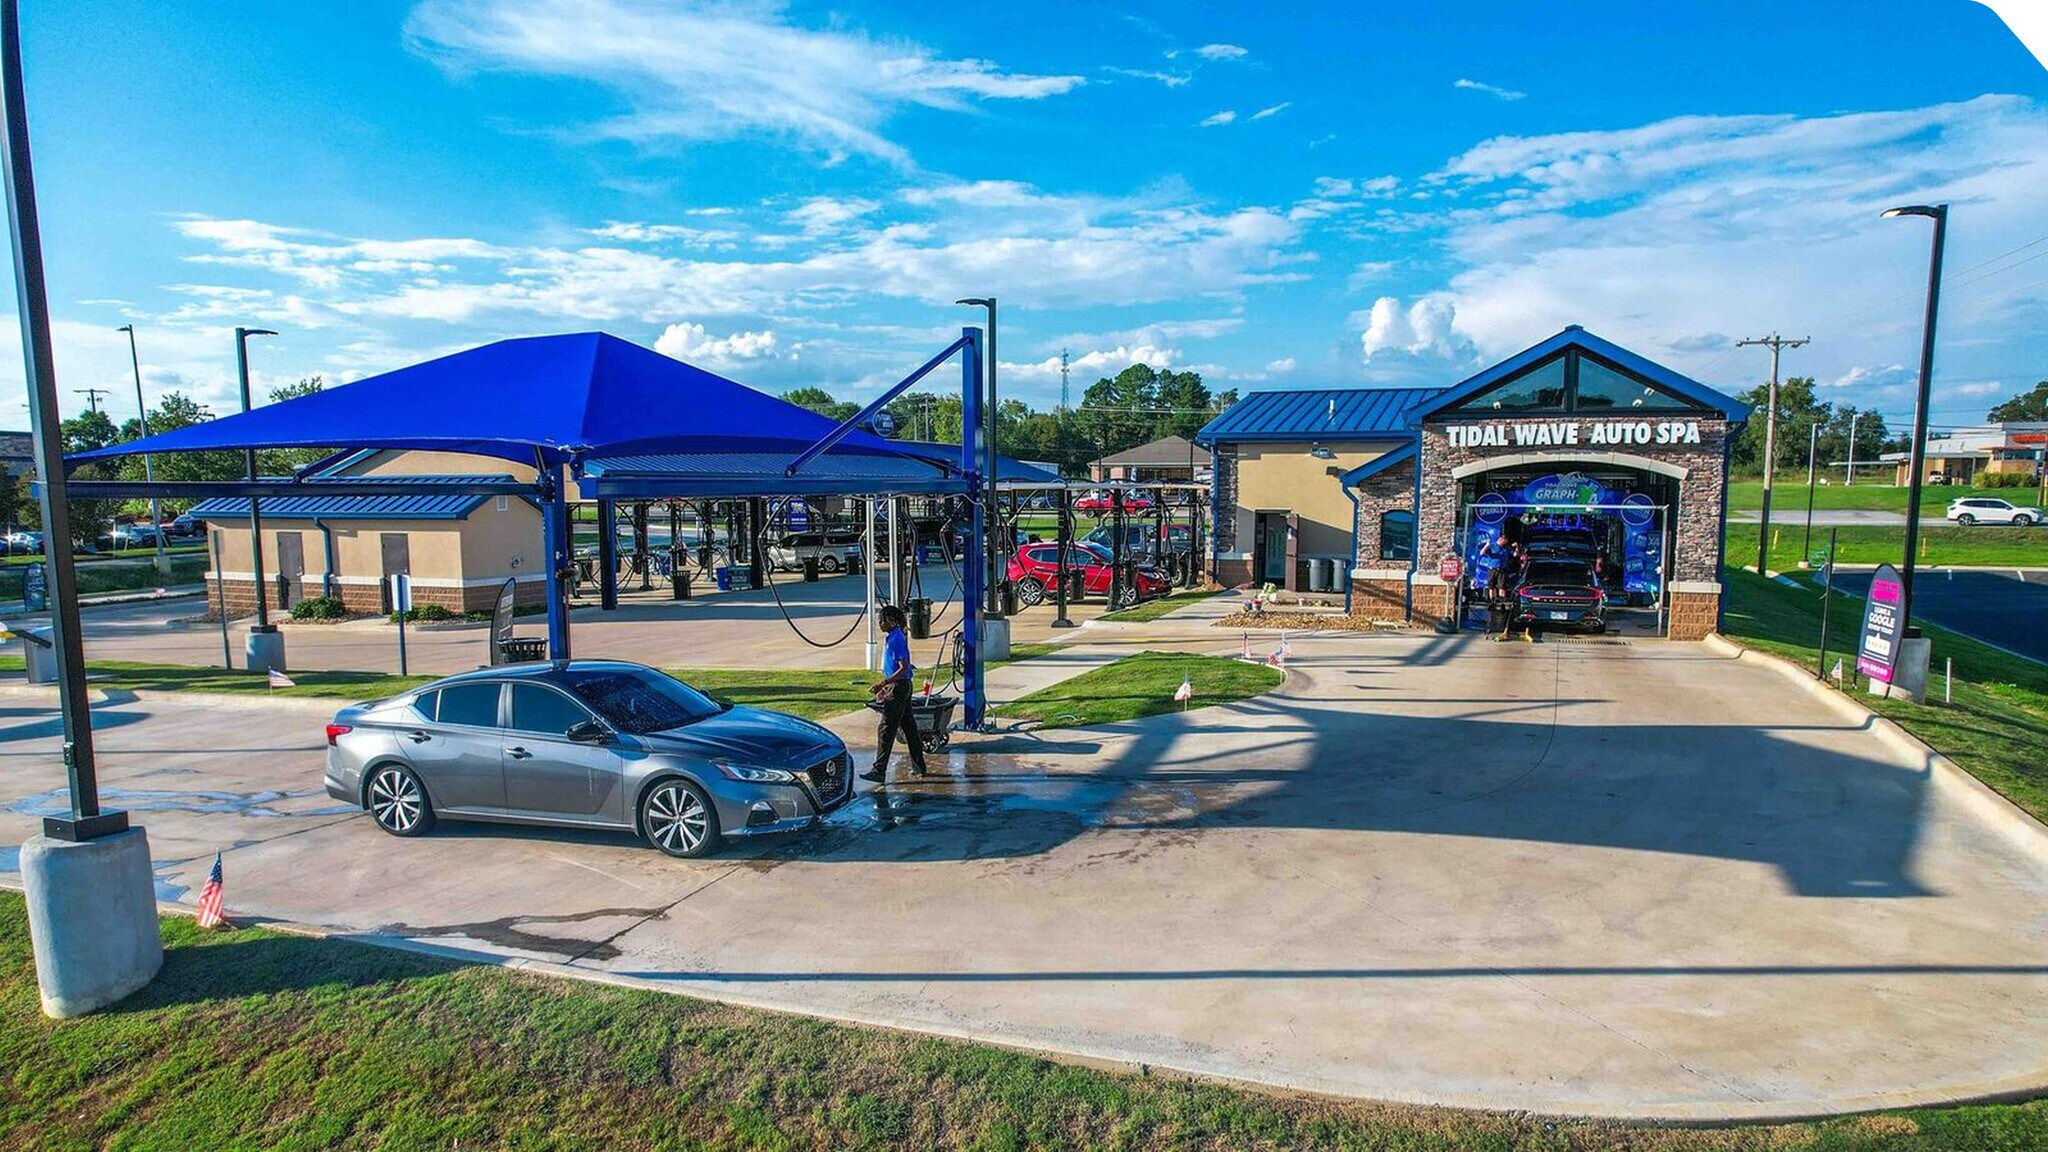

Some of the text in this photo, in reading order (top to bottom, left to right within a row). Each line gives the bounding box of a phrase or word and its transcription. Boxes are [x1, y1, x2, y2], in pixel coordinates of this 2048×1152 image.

[1446, 422, 1701, 447] TIDAL WAVE AUTO SPA
[1869, 612, 1895, 628] GOOGLE
